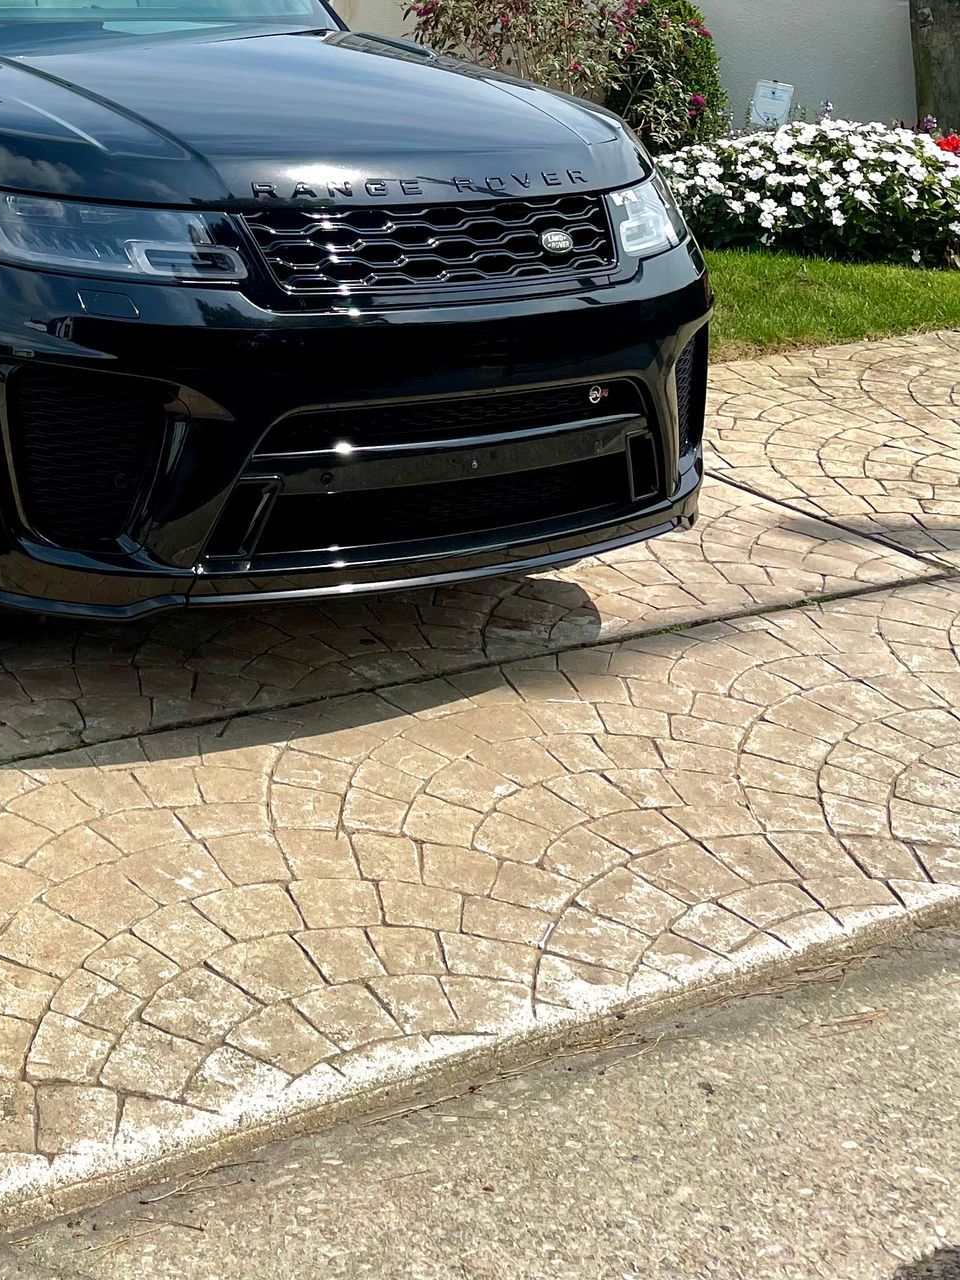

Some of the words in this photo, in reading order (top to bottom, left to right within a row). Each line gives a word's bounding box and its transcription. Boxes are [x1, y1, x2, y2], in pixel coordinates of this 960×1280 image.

[251, 179, 423, 199] RANGE
[451, 169, 588, 193] ROVER
[551, 241, 570, 249] ROVER
